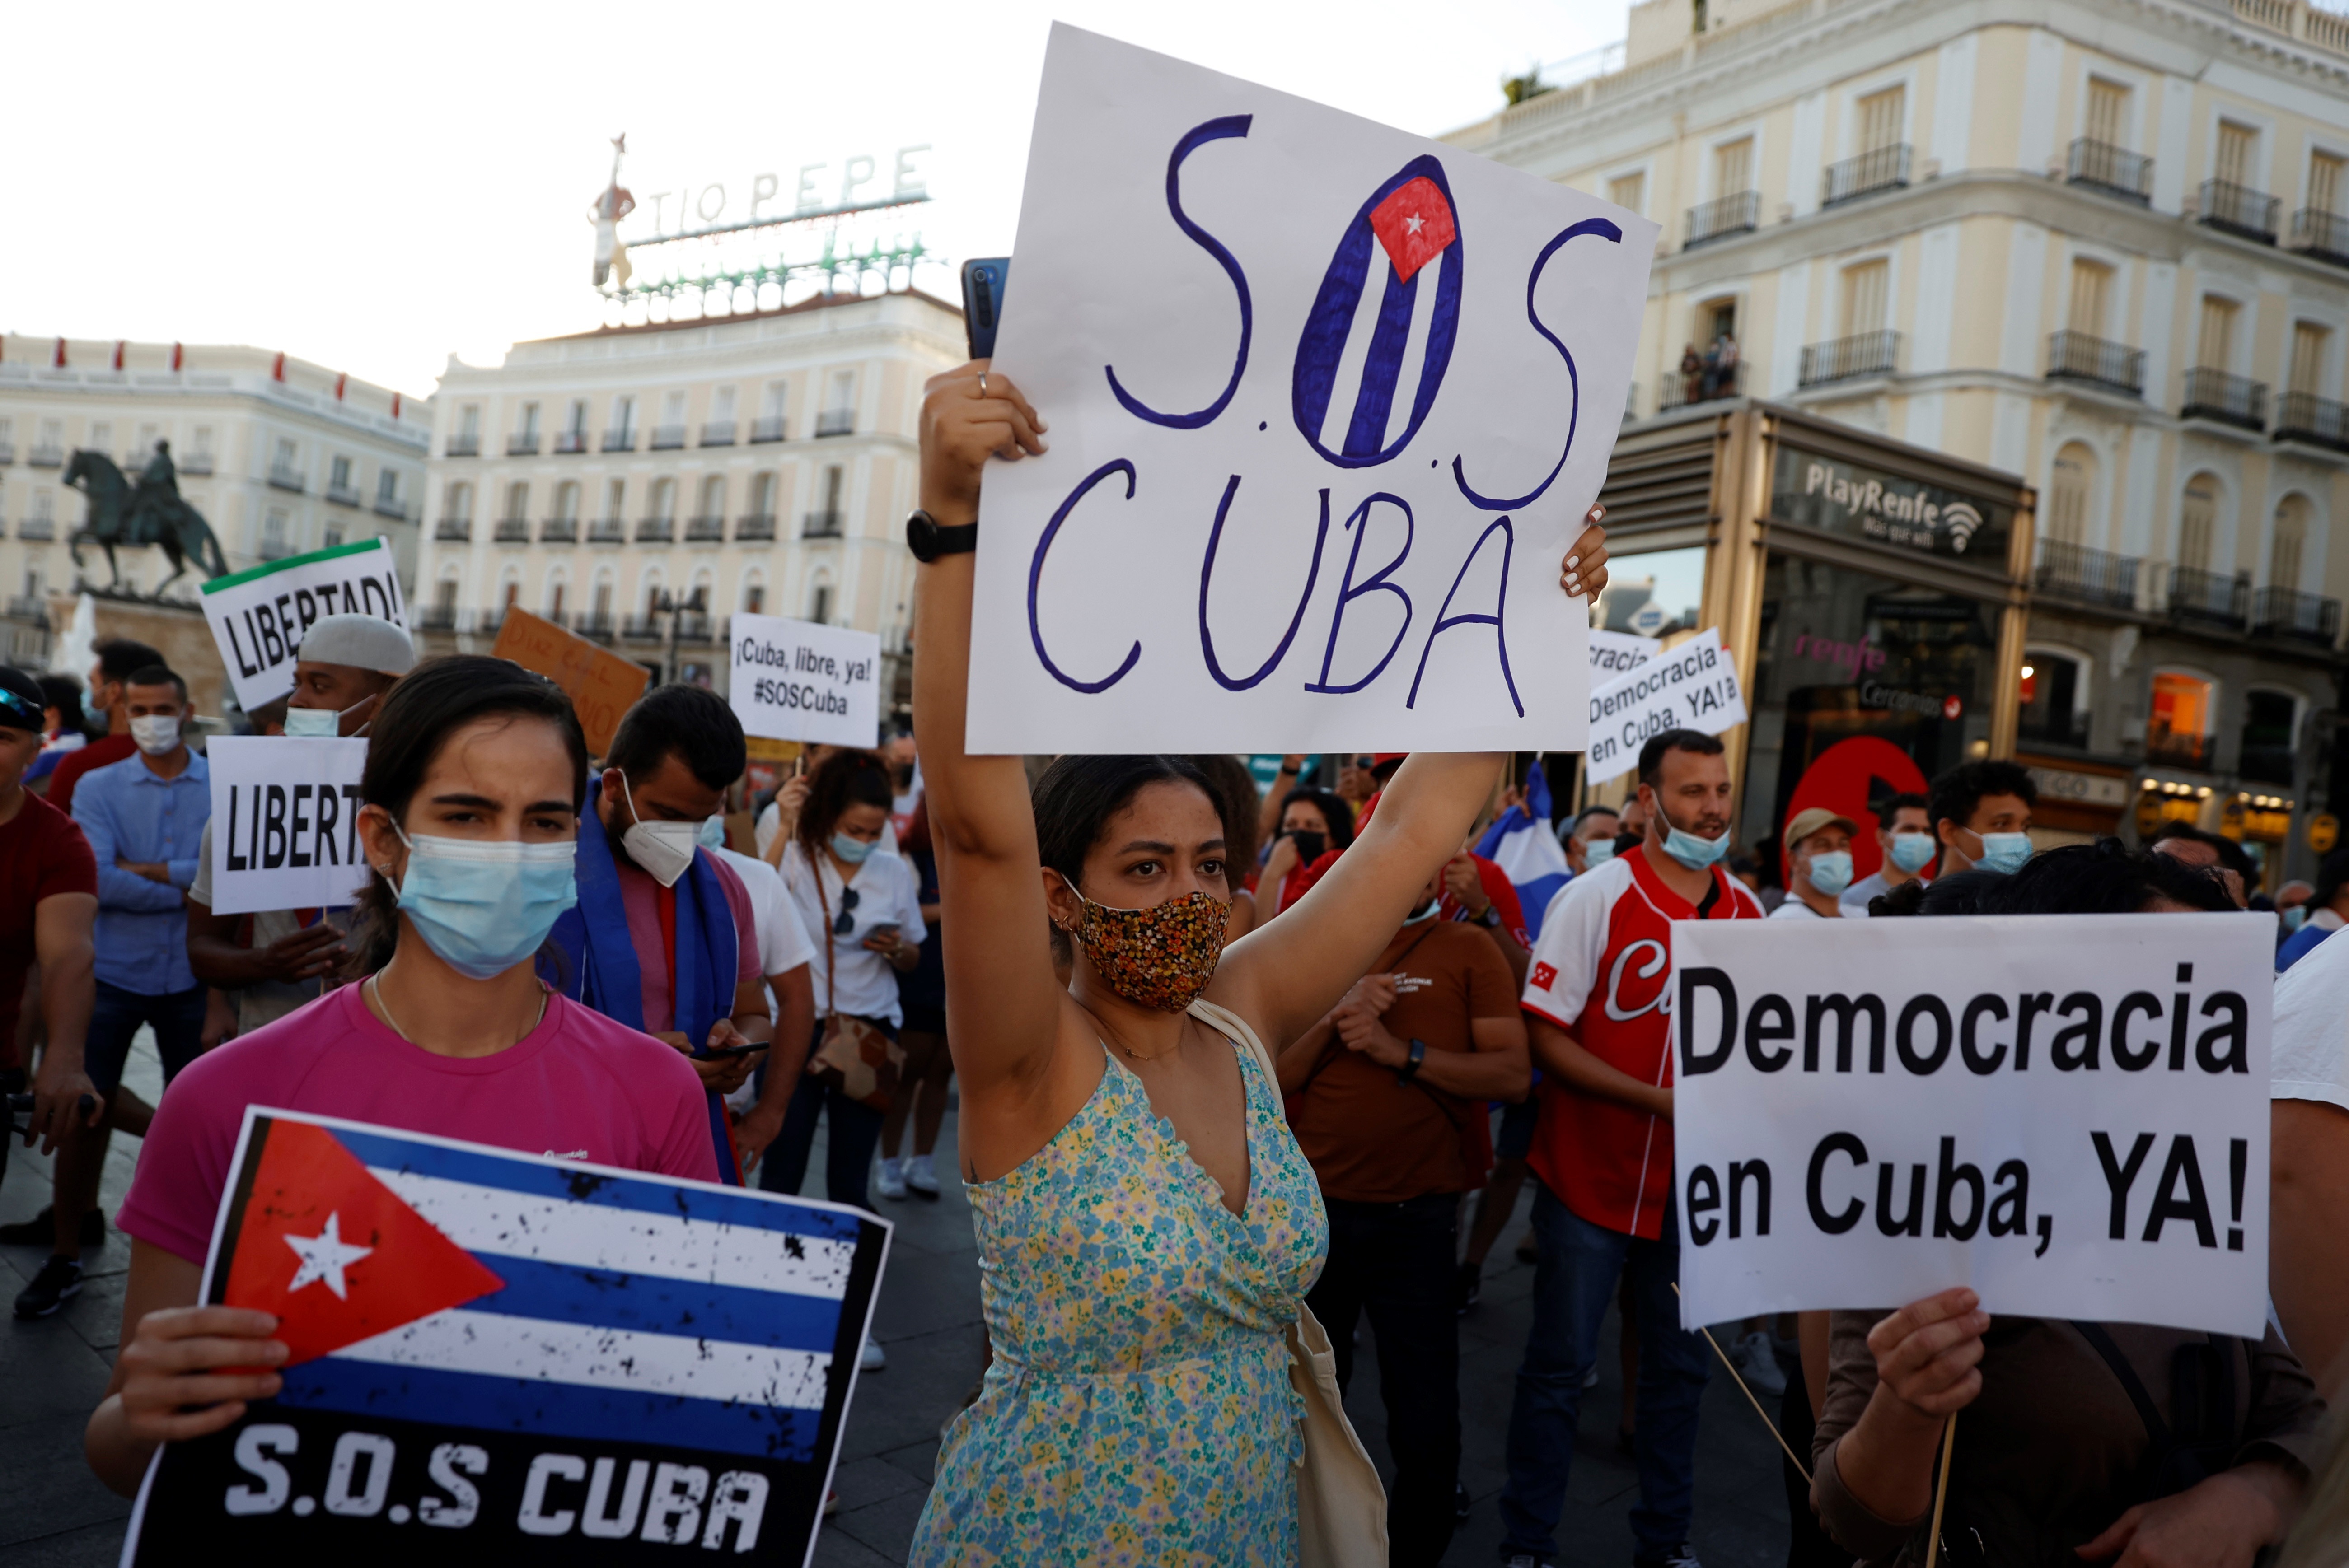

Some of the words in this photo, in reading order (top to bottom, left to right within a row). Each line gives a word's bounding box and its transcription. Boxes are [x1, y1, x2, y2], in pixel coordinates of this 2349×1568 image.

[649, 182, 726, 231] TIO
[750, 143, 931, 215] PEPE
[1105, 114, 1623, 510] S.O.S
[1806, 463, 1940, 528] PlayRenfe
[1028, 458, 1524, 718] CUBA
[736, 637, 789, 672] ¡Cuba,
[795, 646, 840, 680] libre,
[845, 658, 871, 685] ya!
[754, 677, 847, 715] #SOSCuba
[1590, 646, 1717, 723] Democracia
[1794, 634, 1887, 681] renfe
[1592, 736, 1616, 762] en
[1686, 680, 1724, 717] YA!
[226, 784, 368, 871] LIBERT
[1679, 962, 2249, 1077] Democracia
[1686, 1158, 1772, 1247] en
[1806, 1131, 2053, 1259] Cuba,
[2090, 1131, 2248, 1252] YA!
[226, 1424, 489, 1527] S.O.S
[518, 1453, 770, 1552] CUBA
